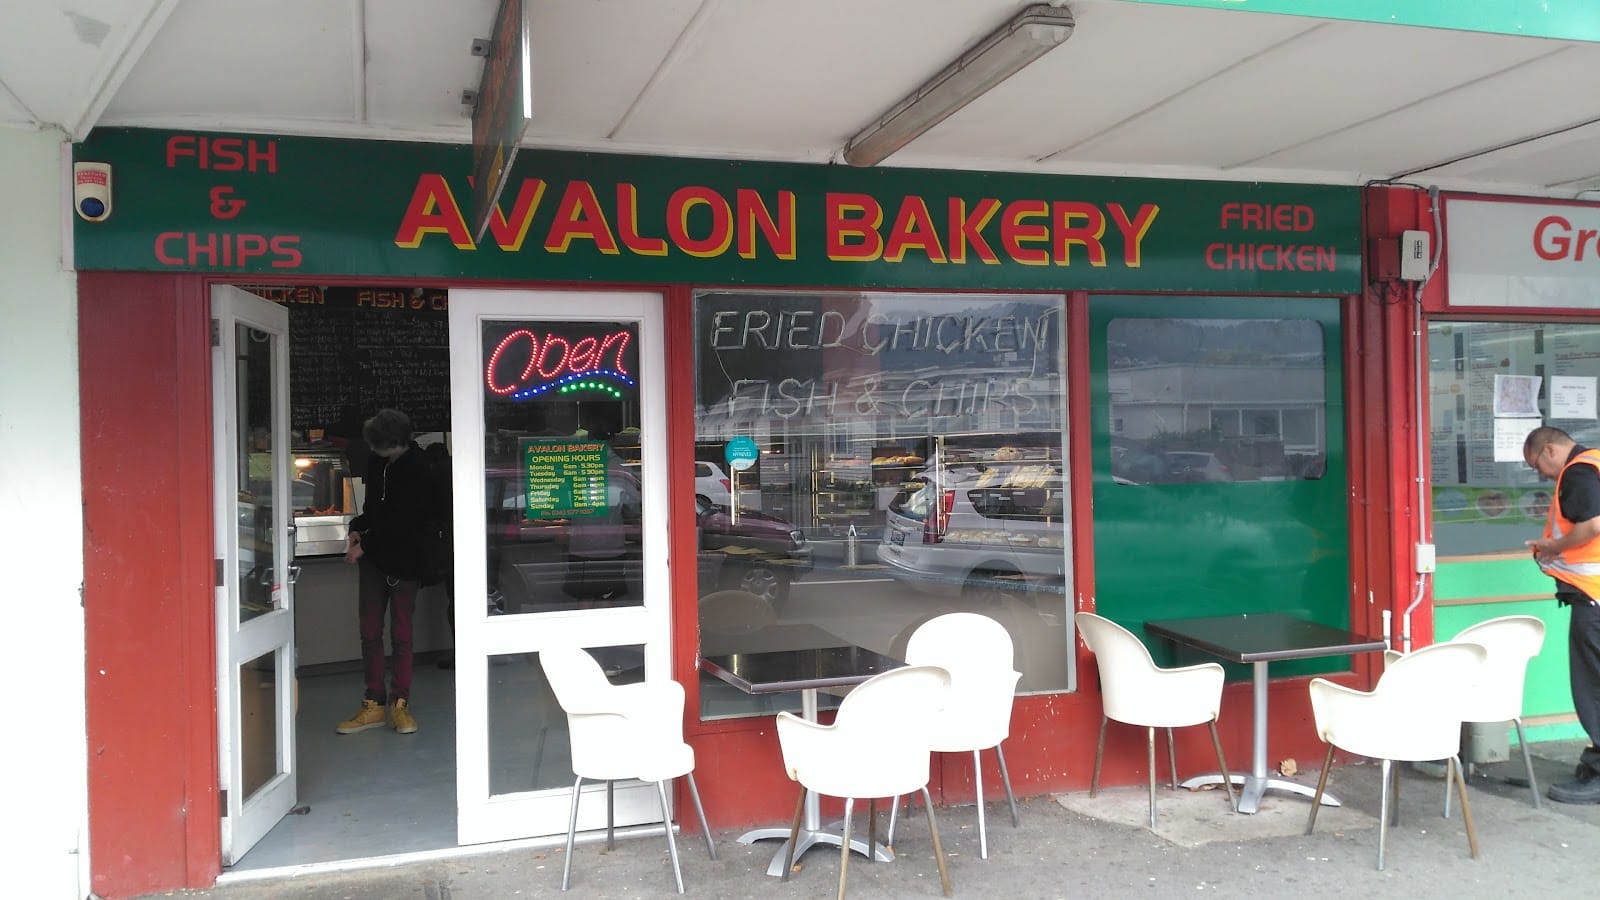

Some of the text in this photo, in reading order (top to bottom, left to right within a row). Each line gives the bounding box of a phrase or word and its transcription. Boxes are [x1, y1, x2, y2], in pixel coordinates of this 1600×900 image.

[166, 135, 277, 173] FISH
[210, 186, 246, 219] &
[395, 173, 1160, 267] AVALON BAKERY
[1221, 202, 1315, 232] FRIED
[154, 231, 303, 268] CHIPS
[1205, 242, 1336, 272] CHICKEN
[1533, 215, 1600, 262] Gr
[357, 289, 405, 308] FISH
[711, 310, 1048, 355] FRIED CHICKEN
[487, 328, 631, 394] Open
[728, 377, 1038, 418] FISH & CHIPS
[528, 444, 604, 453] AVALON BAKERY
